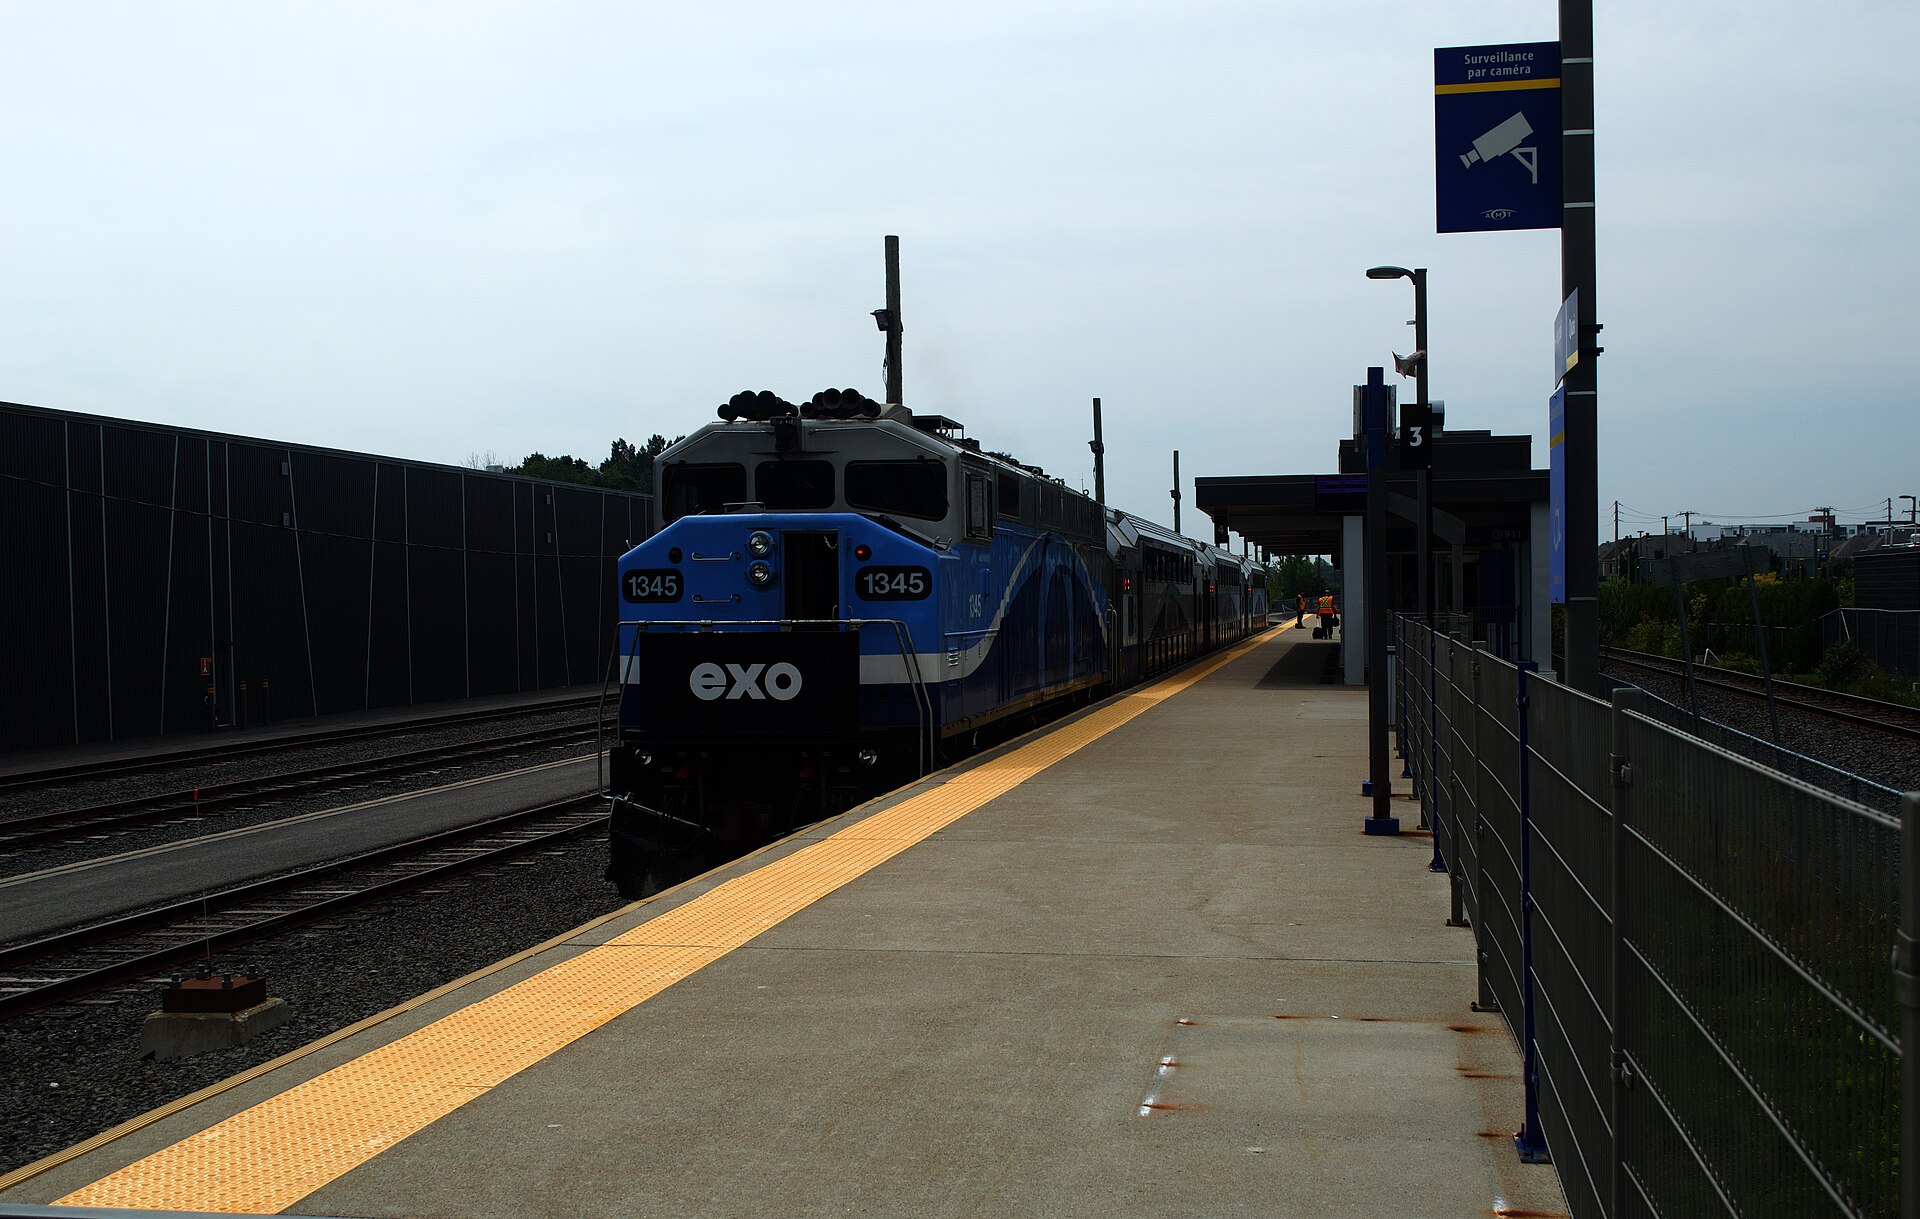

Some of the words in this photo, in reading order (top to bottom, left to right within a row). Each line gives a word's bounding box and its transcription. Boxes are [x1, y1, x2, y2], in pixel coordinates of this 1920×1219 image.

[1464, 51, 1534, 65] Surveillance
[1467, 68, 1486, 80] par
[1490, 64, 1532, 77] caméra
[1409, 426, 1423, 447] 3
[1503, 529, 1521, 540] 911
[628, 575, 677, 598] 1345
[864, 572, 925, 595] 1345
[689, 661, 803, 701] exo
